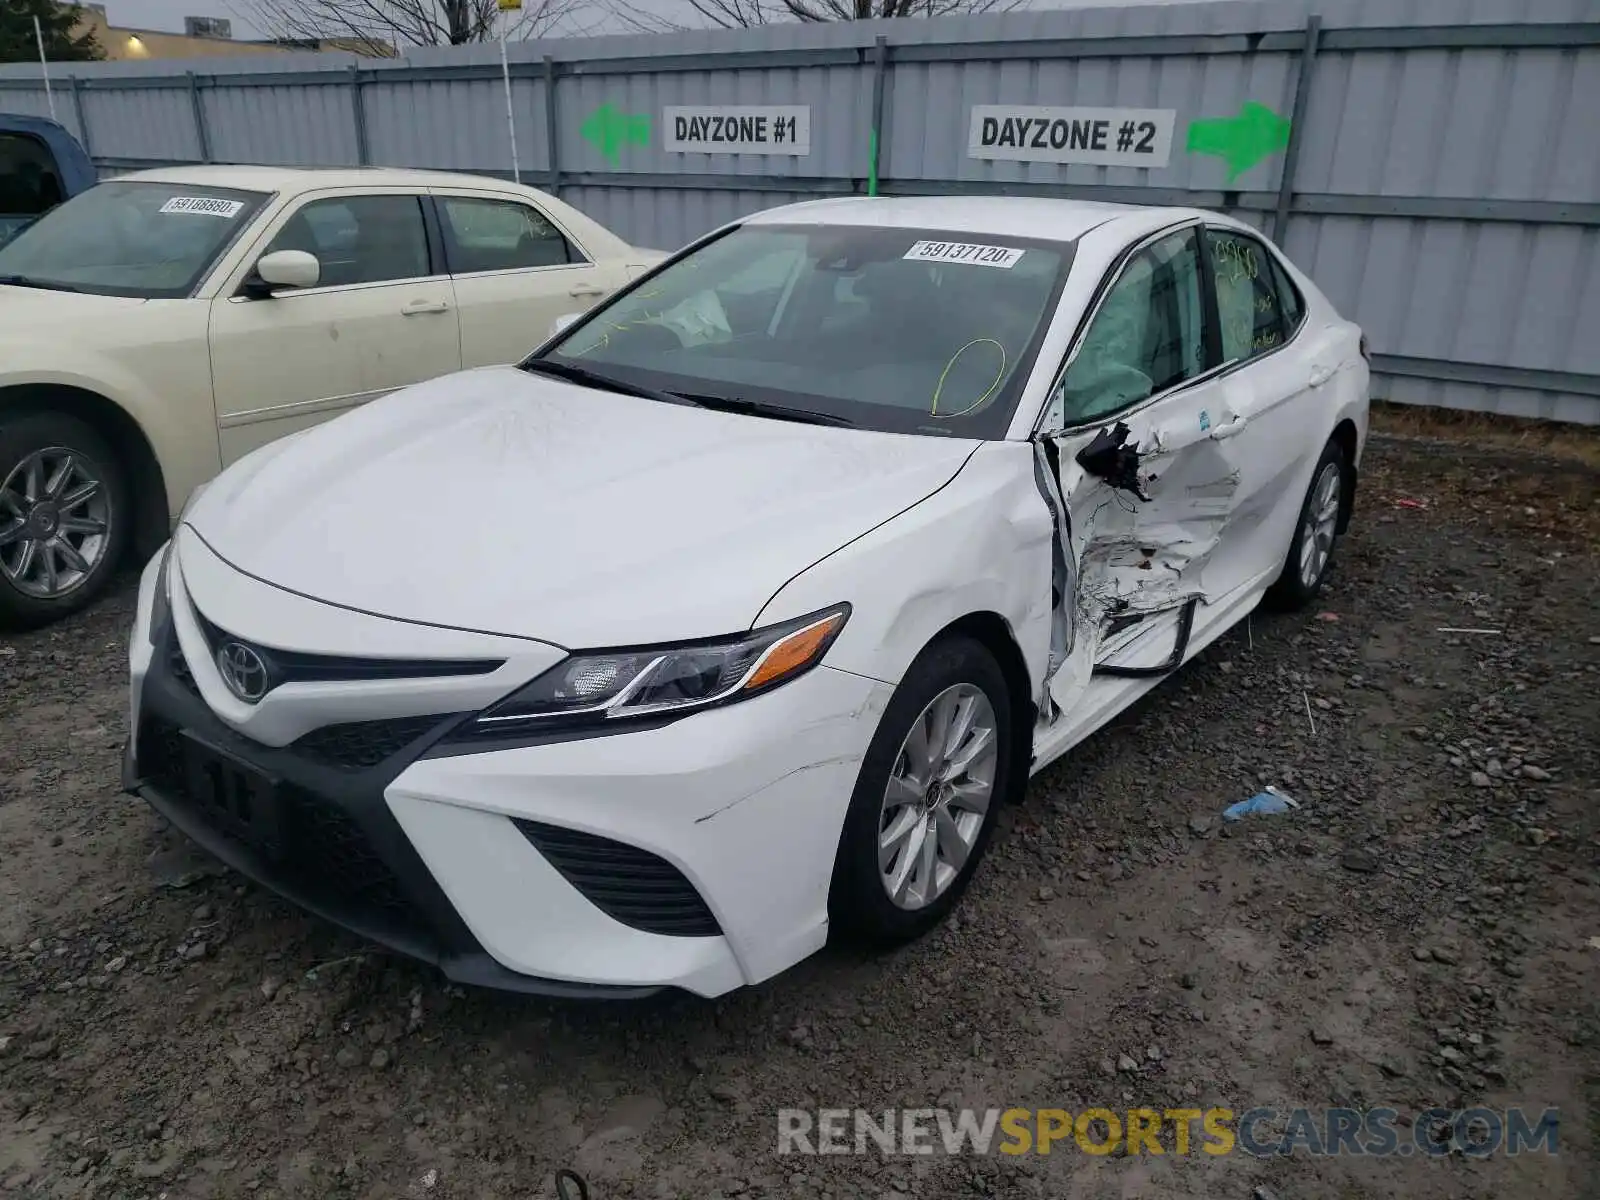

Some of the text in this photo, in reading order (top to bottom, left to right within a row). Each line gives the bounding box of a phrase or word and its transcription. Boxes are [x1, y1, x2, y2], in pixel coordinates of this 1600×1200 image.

[675, 115, 797, 143] DAYZONE #1
[981, 117, 1156, 153] DAYZONE #2
